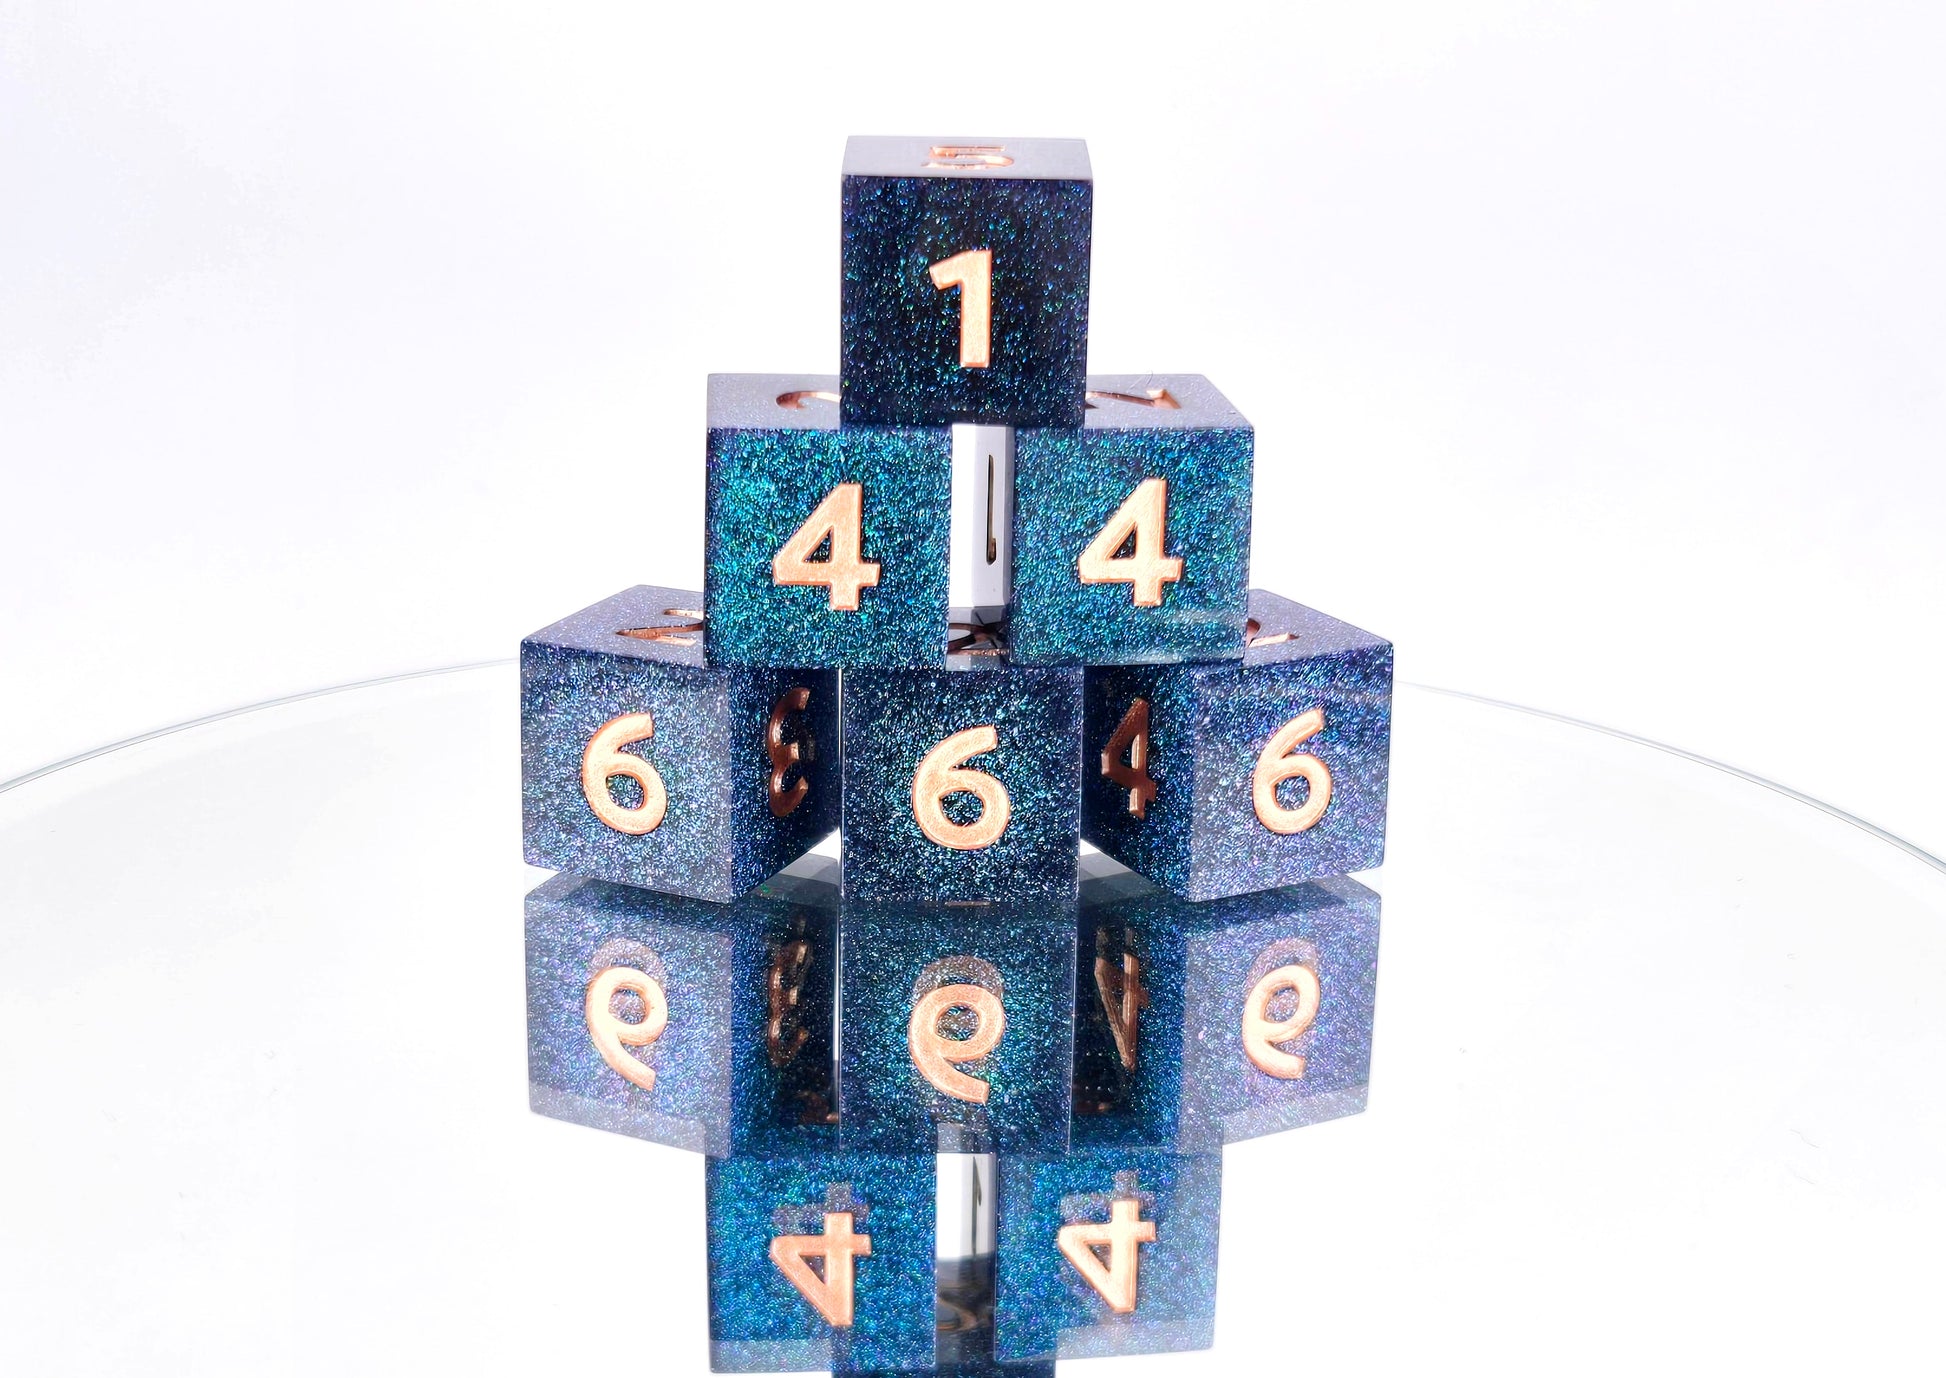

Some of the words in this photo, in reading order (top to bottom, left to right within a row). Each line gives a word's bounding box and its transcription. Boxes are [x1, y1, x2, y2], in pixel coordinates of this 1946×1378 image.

[921, 145, 1014, 170] 5
[928, 248, 993, 369] 1
[772, 481, 881, 612] 4
[1078, 477, 1183, 608] 4
[581, 711, 668, 837] 6
[911, 724, 1010, 850] 6
[1100, 696, 1157, 820] 4
[1252, 707, 1333, 836] 6
